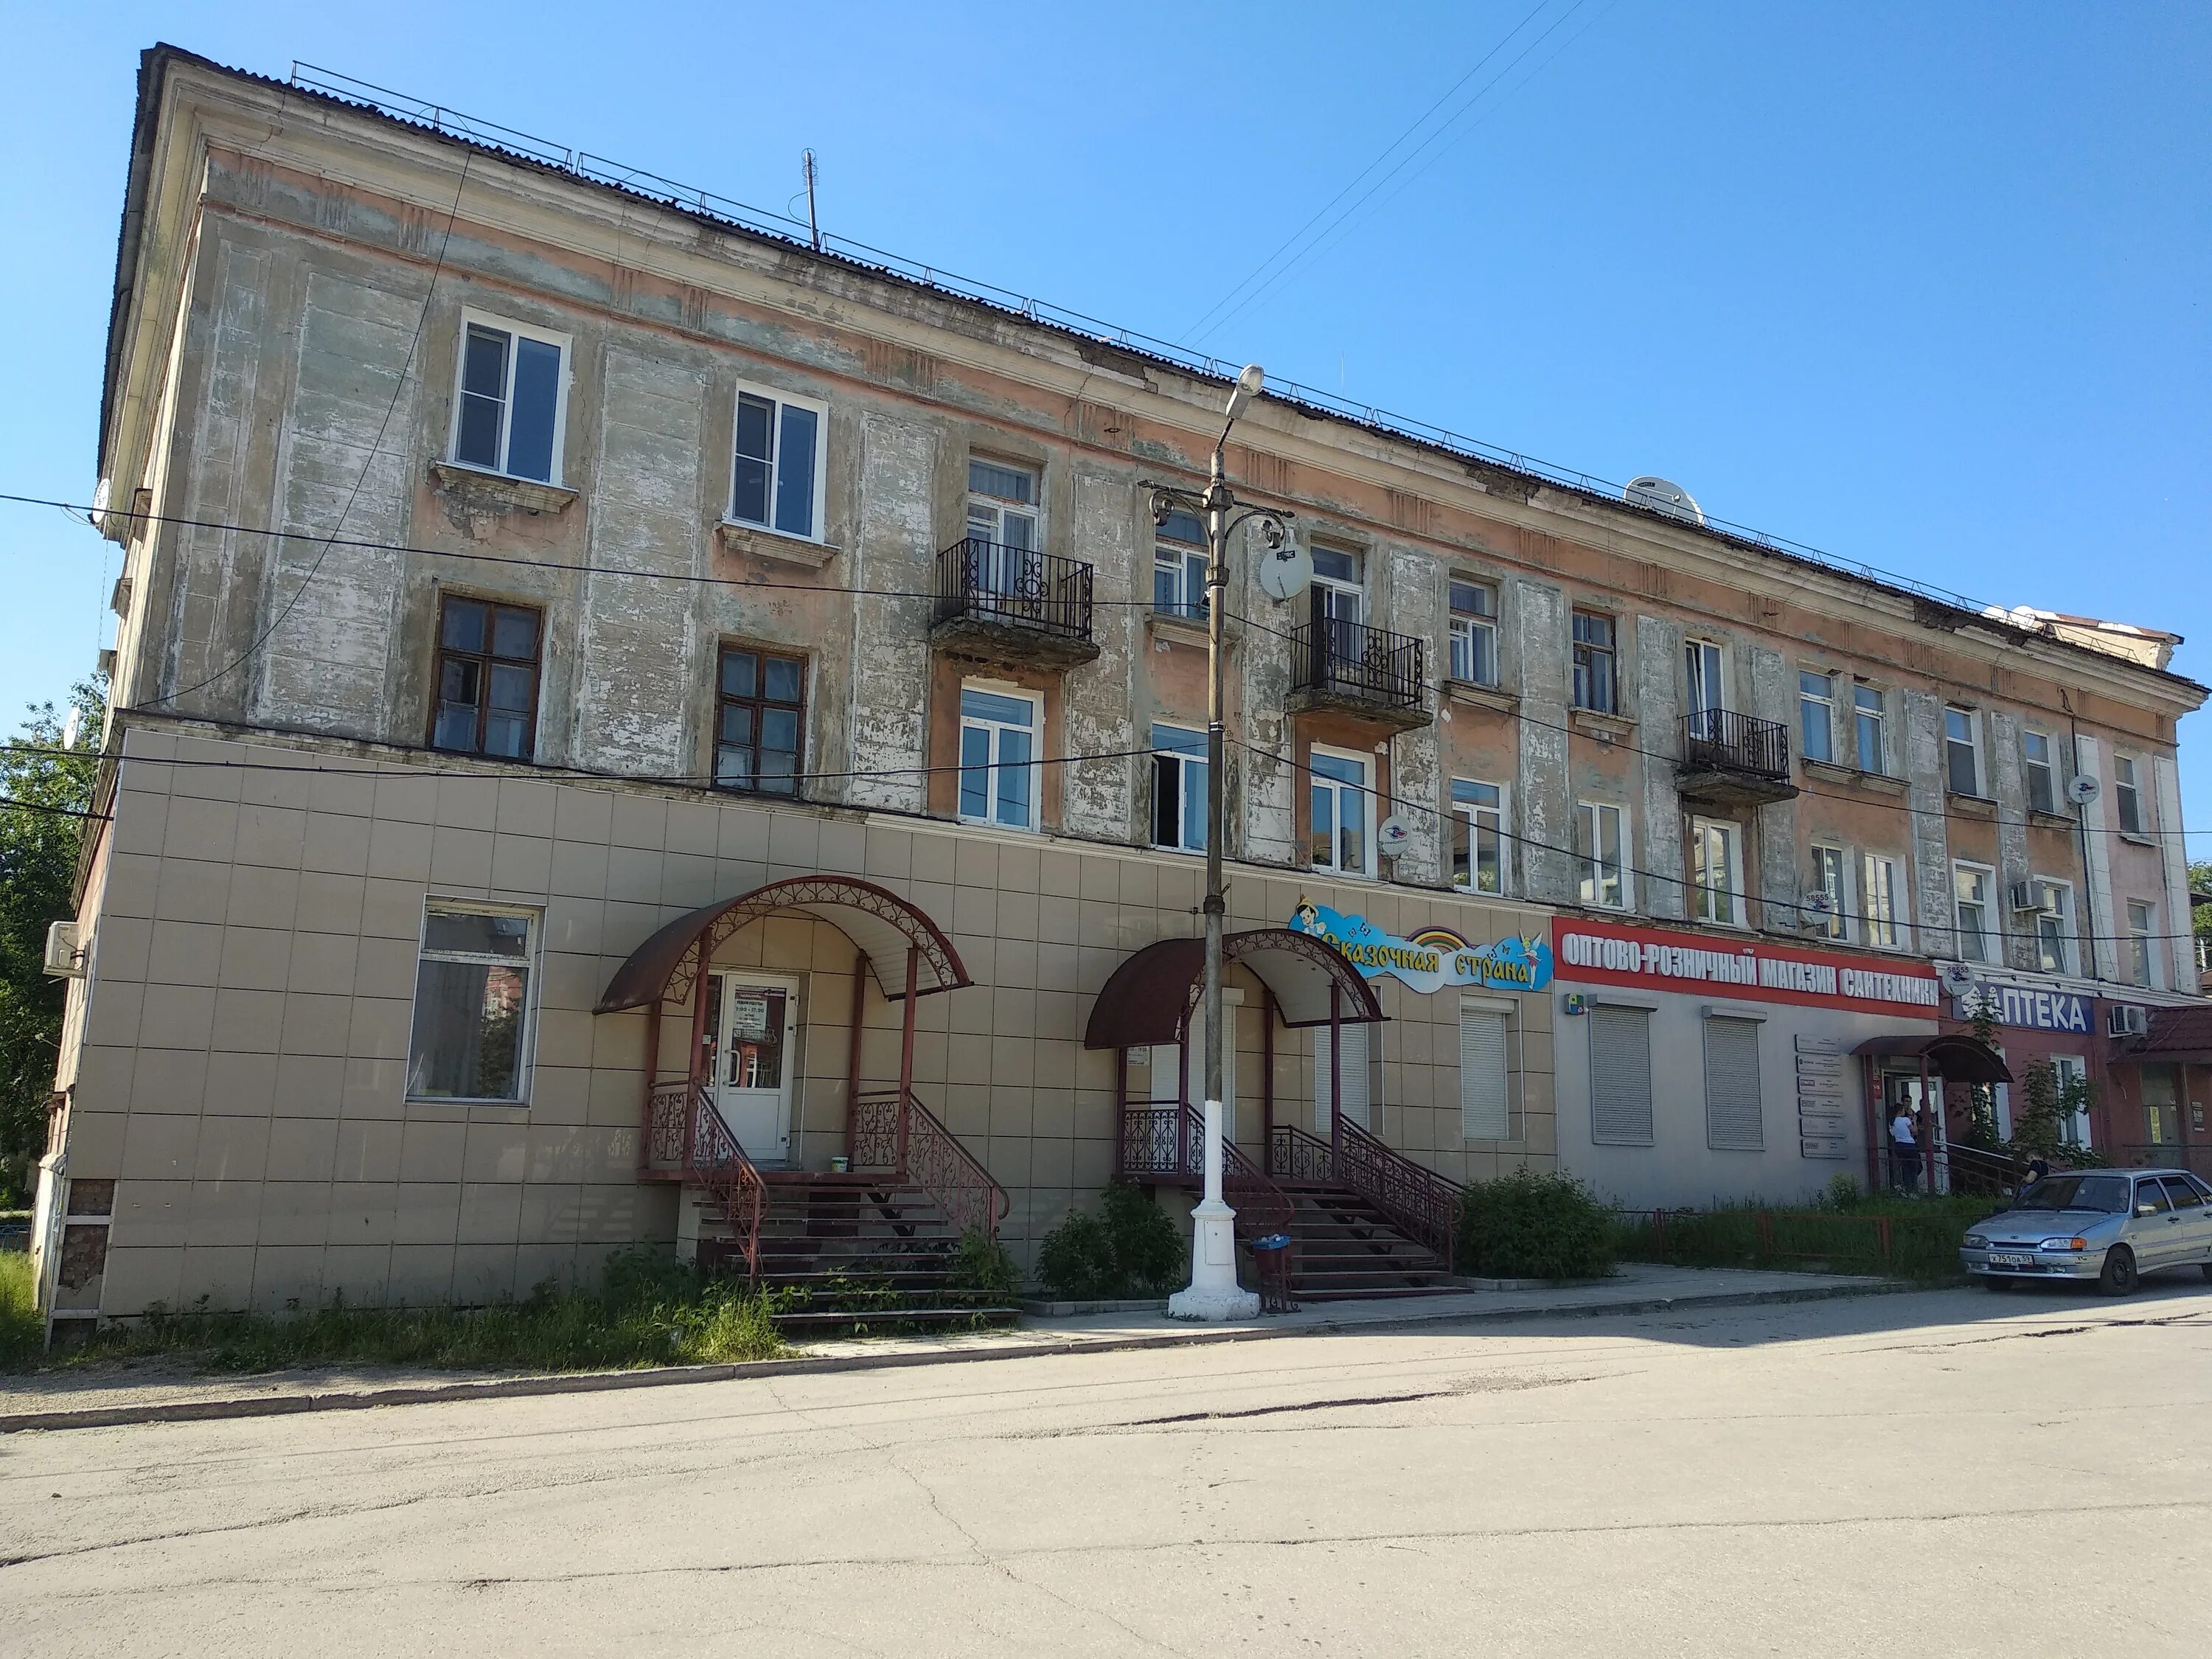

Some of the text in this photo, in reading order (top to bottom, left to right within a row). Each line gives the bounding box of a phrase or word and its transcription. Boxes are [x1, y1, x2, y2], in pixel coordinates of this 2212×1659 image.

[1806, 894, 1829, 902] 58555
[1455, 954, 1528, 986] страна
[1562, 933, 1939, 1007] ОПТОВО-РОЗНИЧНЫЙ МАГАЗИН САНТЕХНИКИ
[1986, 986, 2087, 1032] АПТЕКА
